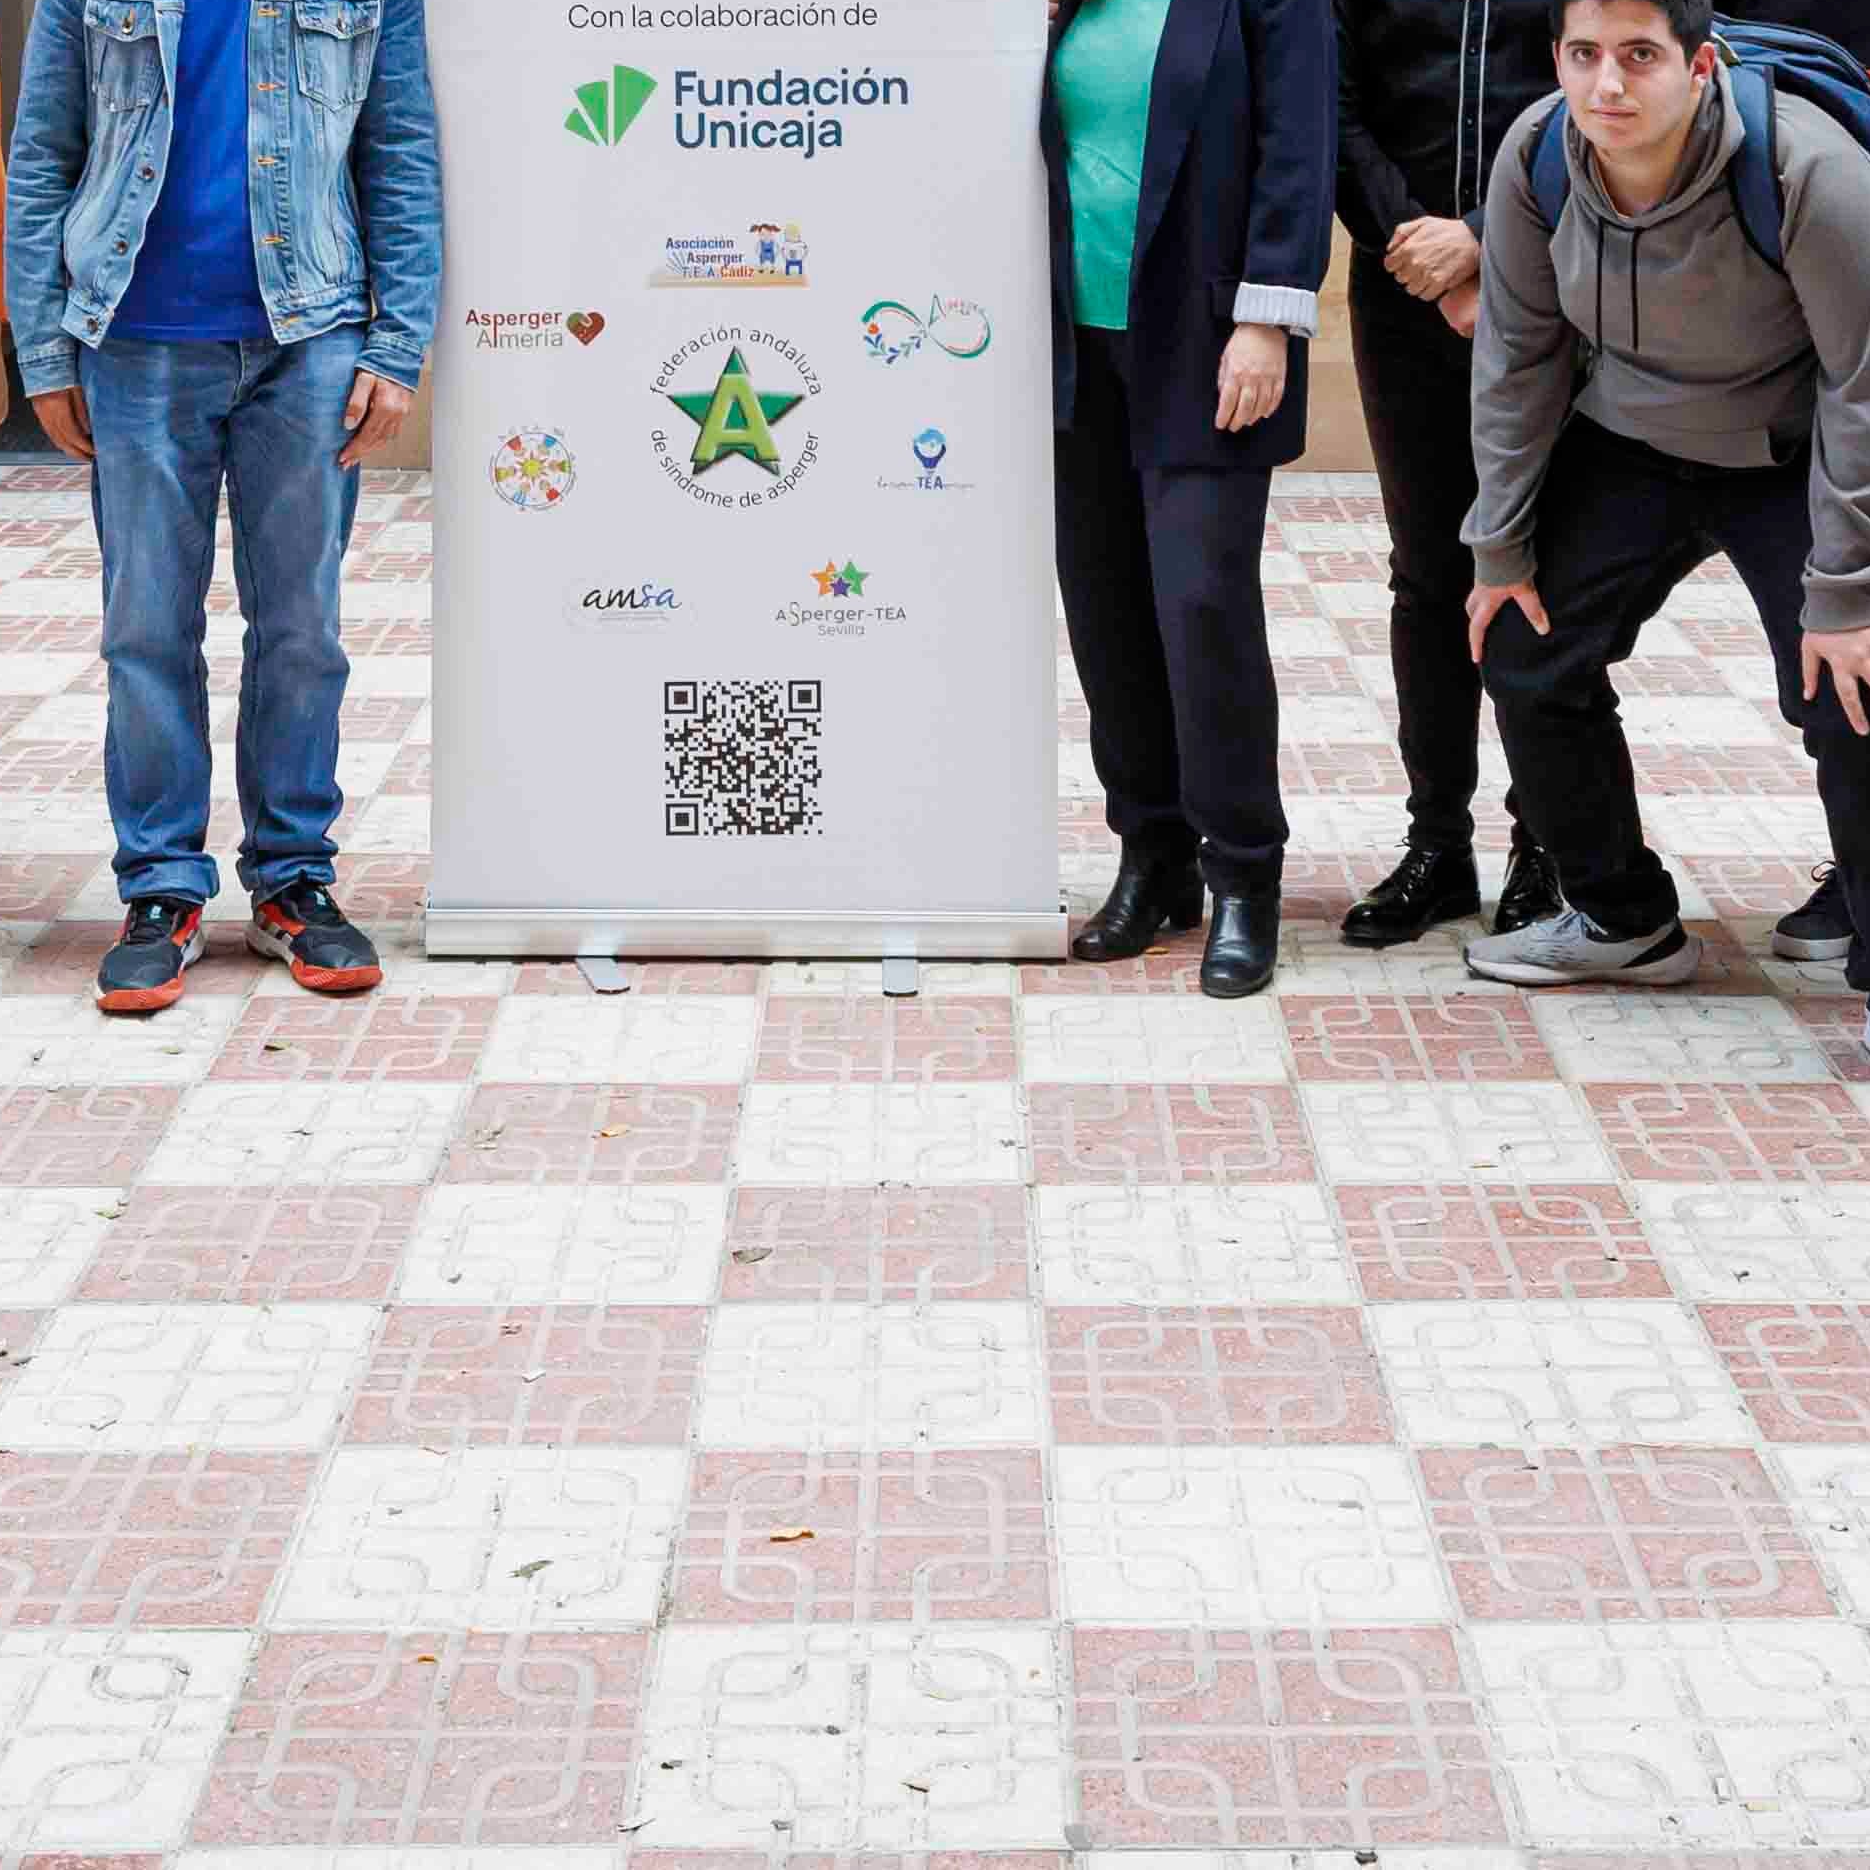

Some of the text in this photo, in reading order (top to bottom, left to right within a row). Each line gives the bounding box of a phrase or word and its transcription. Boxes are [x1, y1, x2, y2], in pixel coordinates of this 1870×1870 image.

[568, 1, 879, 29] Con la colaboración de
[674, 66, 909, 107] Fundación
[675, 109, 843, 160] Unicaja
[686, 252, 744, 266] Asperger
[465, 309, 562, 329] Asperger
[649, 325, 822, 396] federación andaluza
[651, 429, 819, 509] de síndrome de asperger
